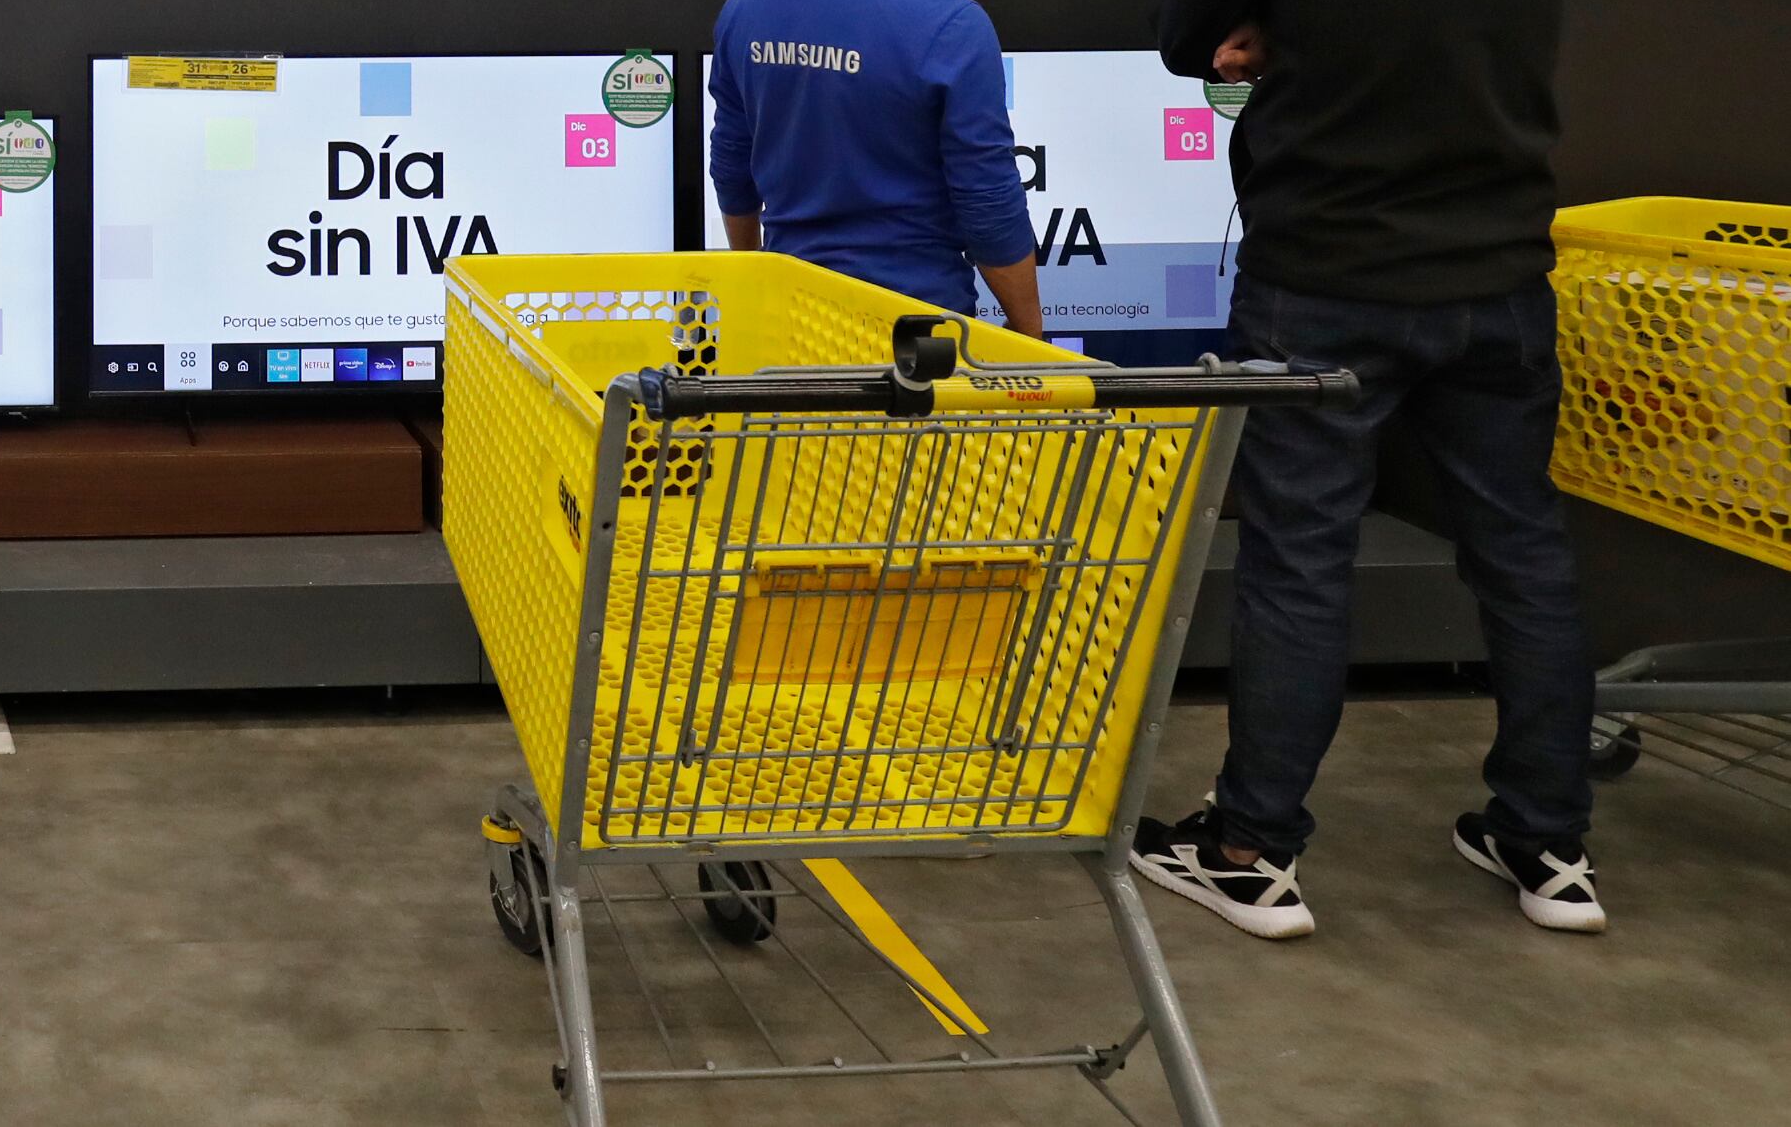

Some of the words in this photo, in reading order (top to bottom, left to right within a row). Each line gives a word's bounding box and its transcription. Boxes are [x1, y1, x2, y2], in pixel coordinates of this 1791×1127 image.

[750, 41, 861, 74] SAMSUNG
[187, 63, 201, 73] 31
[232, 64, 248, 74] 26
[612, 67, 634, 91] SÍ
[570, 122, 587, 131] Dic
[1170, 116, 1185, 125] Dic
[581, 138, 610, 159] 03
[1180, 131, 1208, 151] 03
[327, 134, 444, 201] Día
[265, 210, 371, 277] sin
[396, 215, 500, 275] IVA
[1055, 304, 1068, 316] la
[1071, 302, 1150, 319] tecnología
[223, 314, 277, 331] Porque
[280, 313, 352, 328] sabemos
[354, 316, 385, 331] que
[387, 314, 403, 326] te
[304, 361, 331, 370] NETFLIX
[179, 376, 197, 385] Apps
